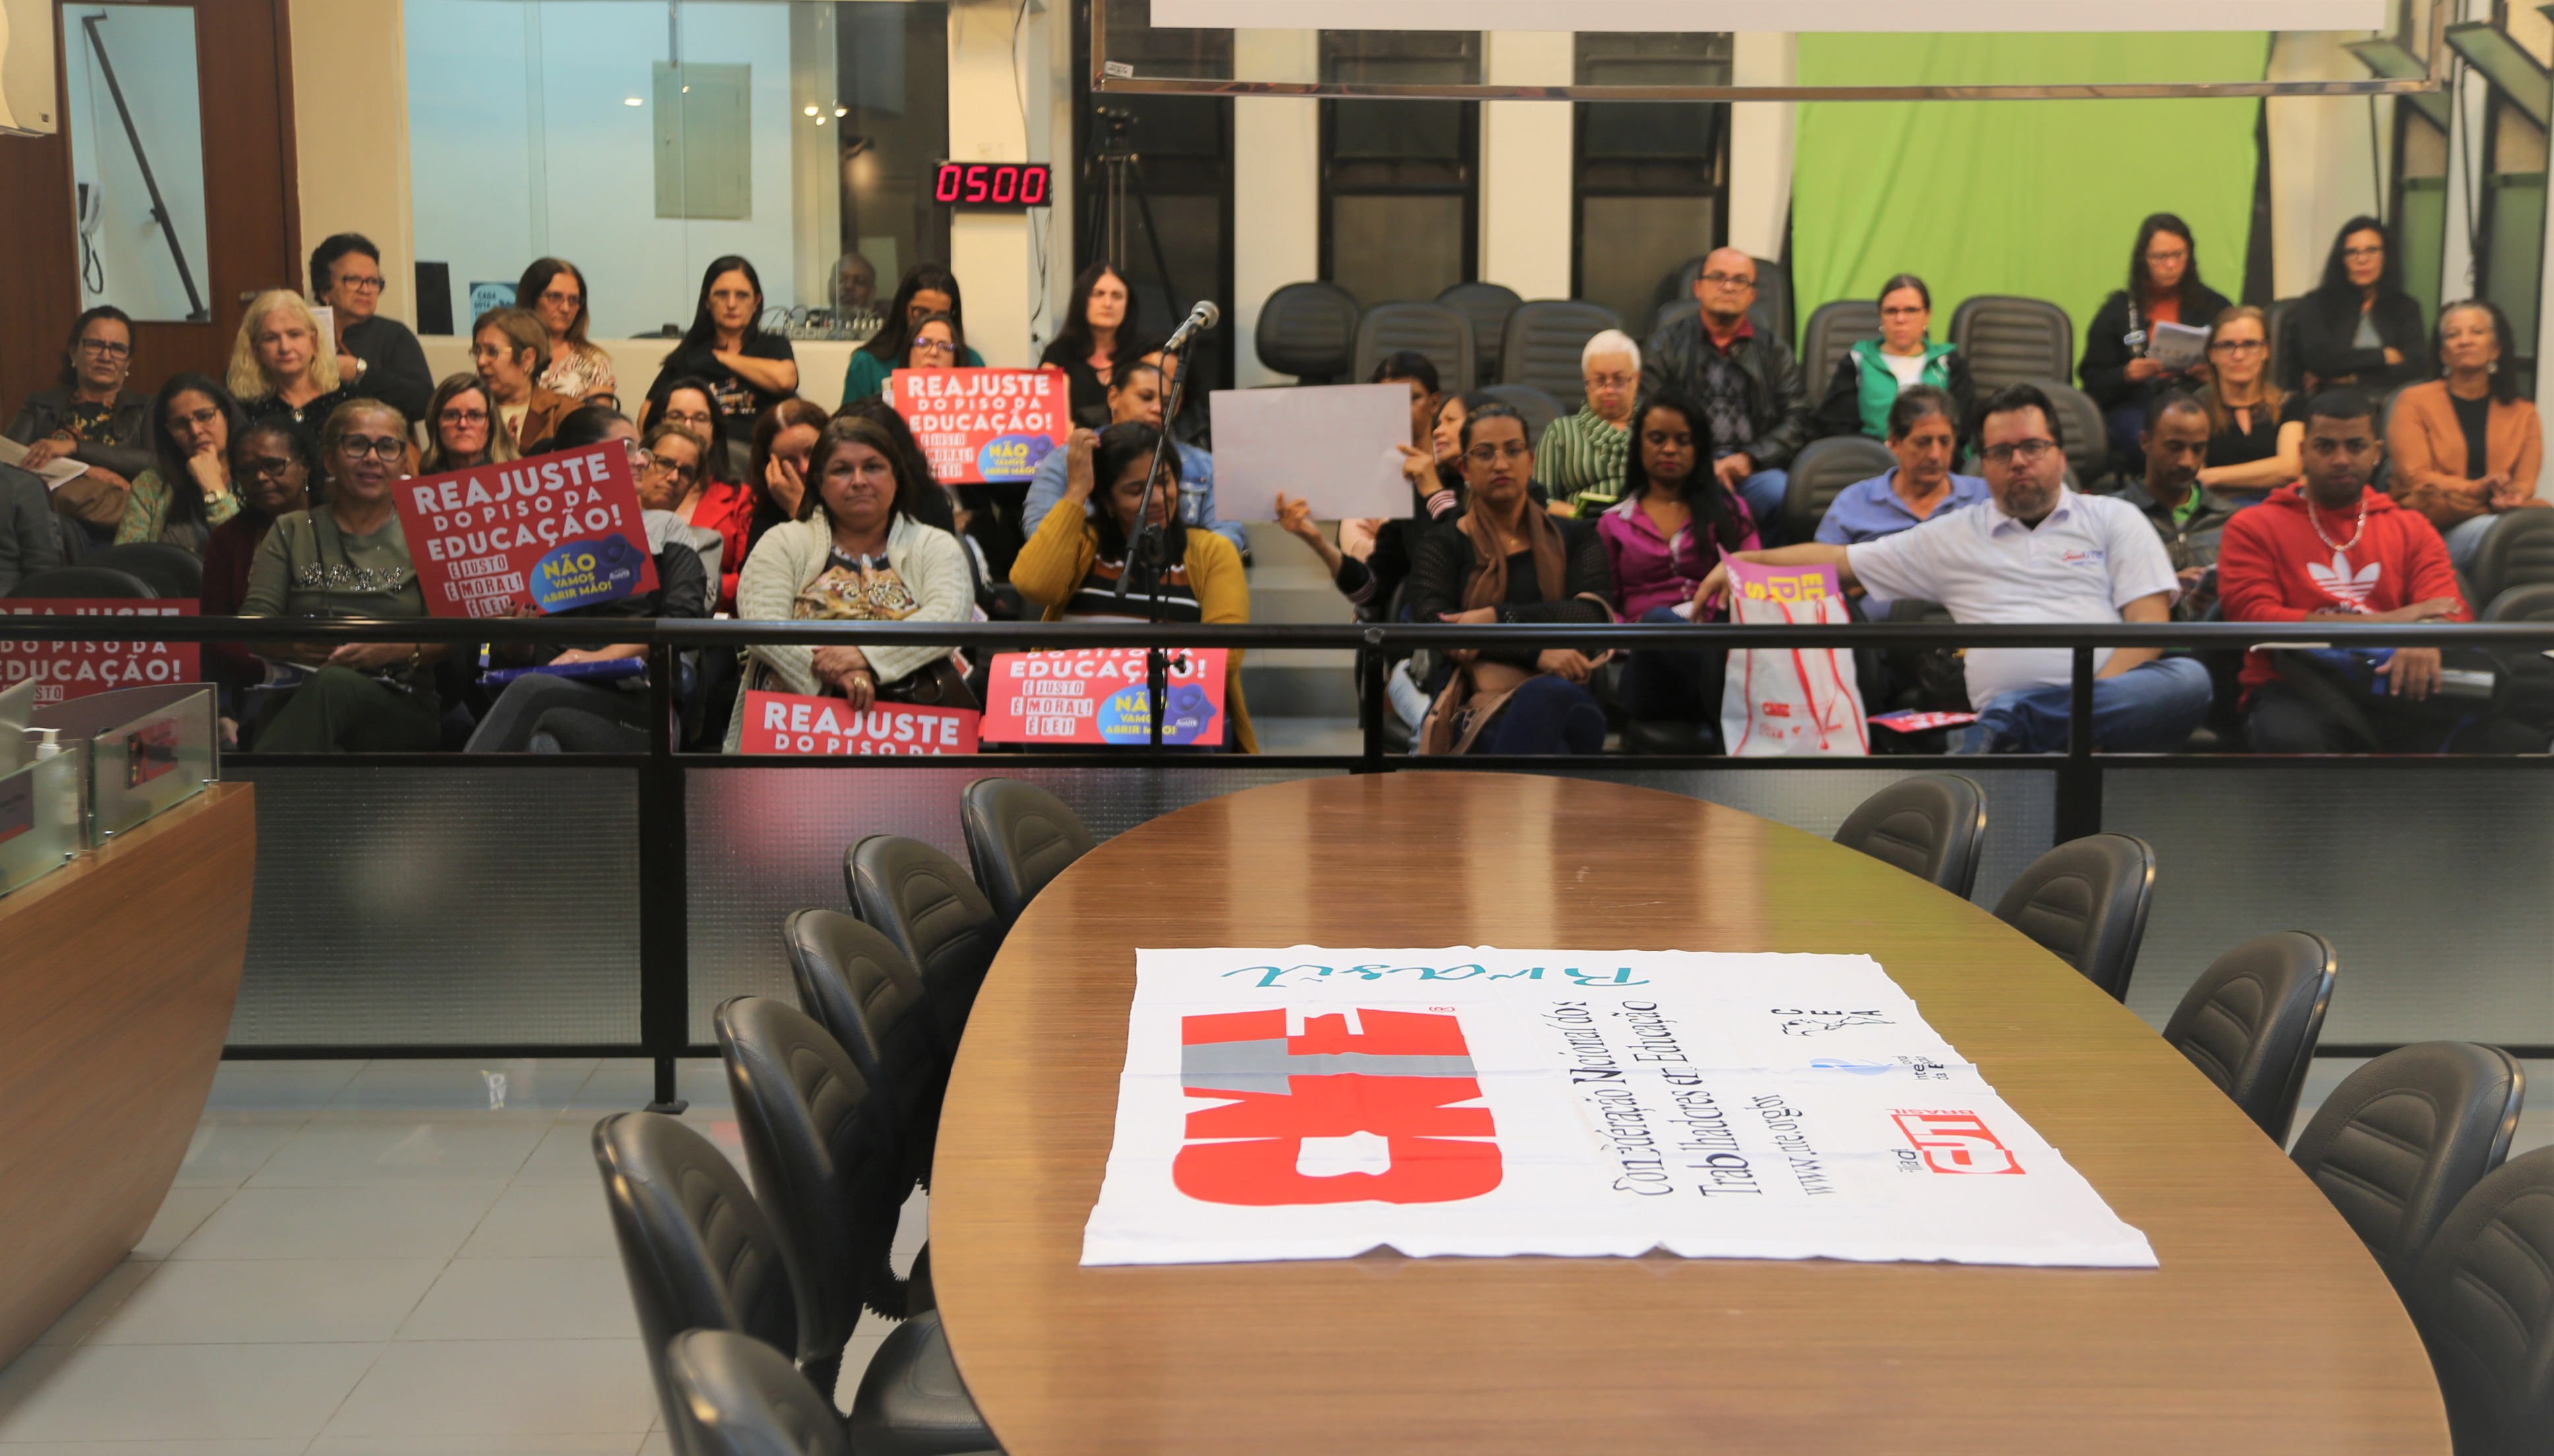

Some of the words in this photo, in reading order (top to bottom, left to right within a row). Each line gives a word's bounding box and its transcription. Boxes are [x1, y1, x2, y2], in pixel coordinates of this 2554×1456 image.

[908, 374, 1050, 398] REAJUSTE
[918, 398, 947, 411] DO
[955, 397, 1006, 411] PISO
[1014, 396, 1042, 410] DA
[909, 410, 1052, 435] EDUCAÇÃO!
[990, 440, 1028, 458] NÃO
[412, 452, 610, 515] REAJUSTE
[433, 512, 472, 531] DO
[483, 496, 552, 523] PISO
[564, 486, 602, 507] DA
[427, 504, 623, 561] EDUCAÇÃO!
[464, 555, 507, 575] JUSTO
[542, 553, 596, 580] NÃO
[462, 574, 523, 595] MORAL!
[542, 588, 577, 603] ABRIR
[578, 580, 612, 599] MÃO!
[552, 573, 595, 588] VAMOS
[53, 641, 119, 653] PISO
[0, 655, 180, 686] DUCAÇÃO!
[1010, 659, 1206, 683] EDUCAÇO!
[1037, 681, 1082, 694] JUSTO
[1028, 699, 1092, 715] MORAL!
[764, 701, 960, 746] REAJUSTE
[1042, 718, 1075, 734] LEI!
[1106, 725, 1139, 735] ABRIR
[775, 734, 814, 752] DO
[827, 737, 896, 754] PISO
[1540, 1001, 1593, 1023] dos
[1610, 1000, 1689, 1063] Educação
